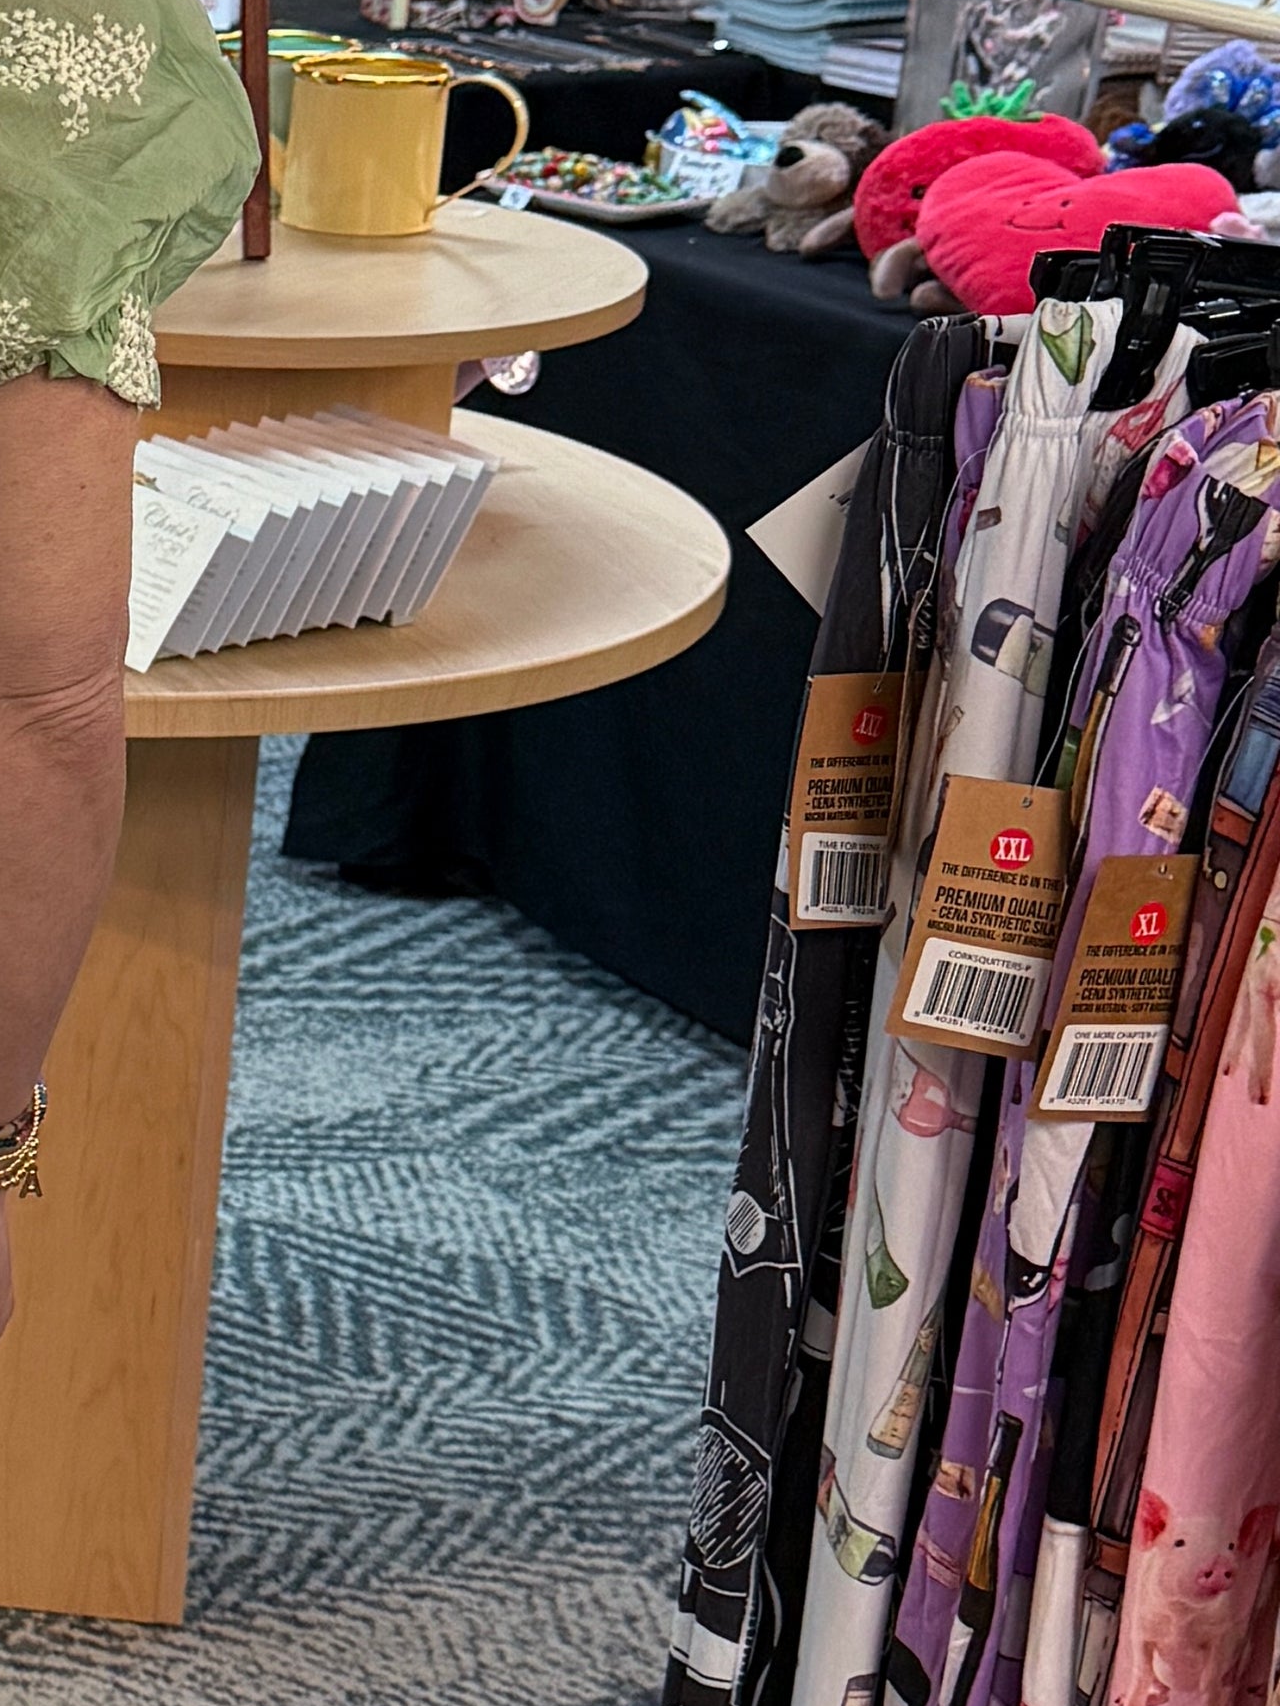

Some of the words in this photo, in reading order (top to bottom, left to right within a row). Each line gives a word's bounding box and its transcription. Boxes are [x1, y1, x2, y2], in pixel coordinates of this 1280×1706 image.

[807, 778, 863, 796] PREMIUM
[818, 840, 838, 850] TIME
[840, 840, 858, 851] FOR
[994, 836, 1032, 862] XXL
[941, 862, 959, 876] THE
[961, 865, 1019, 886] DIFFERENCE
[1019, 874, 1029, 887] IS
[1030, 876, 1041, 889] IN
[934, 885, 1006, 913] PREMIUM
[1007, 896, 1060, 922] QUALIT
[970, 910, 1032, 934] SYNTHETIC
[1134, 912, 1160, 938] XL
[1079, 968, 1138, 987] PREMIUM
[1074, 1031, 1091, 1040] ONE
